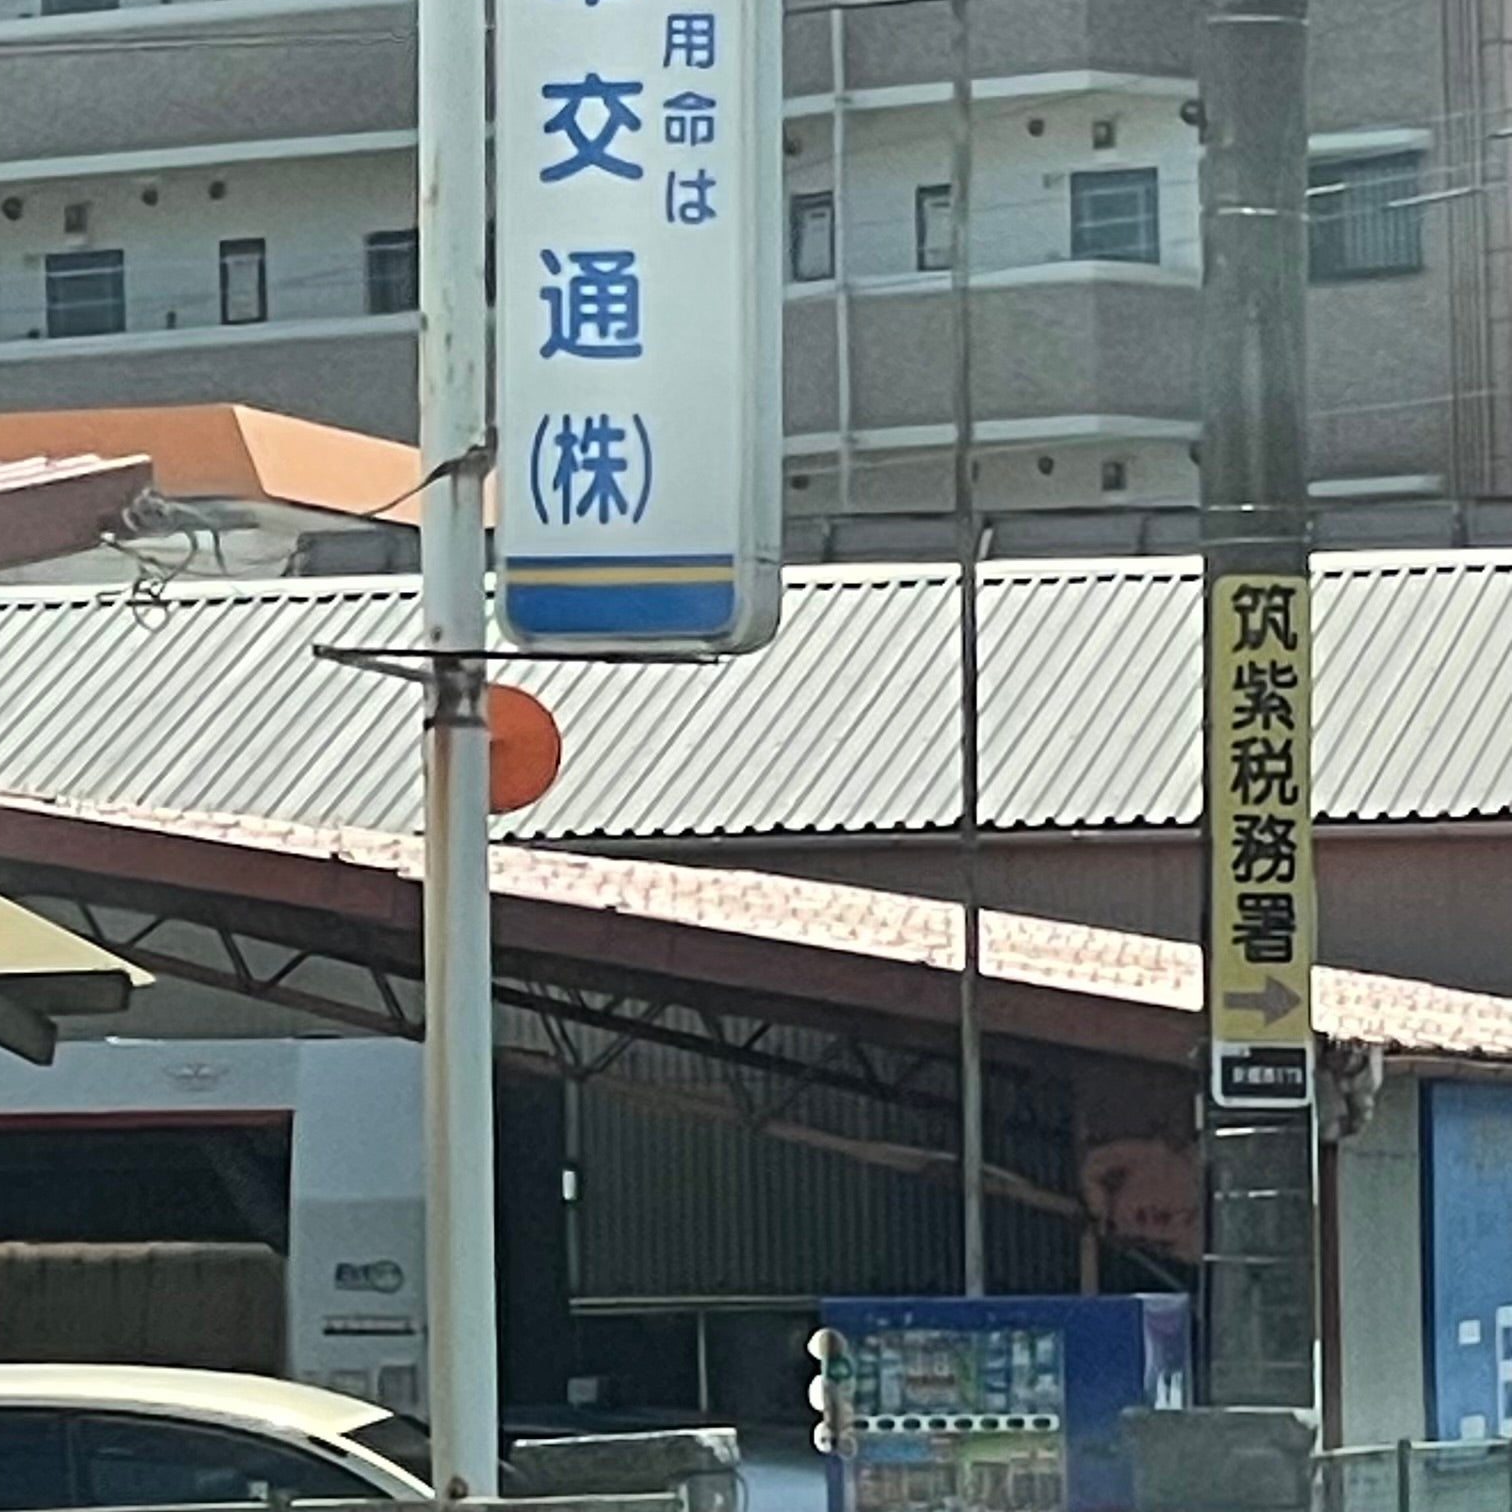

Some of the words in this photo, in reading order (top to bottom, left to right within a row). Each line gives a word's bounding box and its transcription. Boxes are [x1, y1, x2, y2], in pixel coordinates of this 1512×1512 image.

[1230, 583, 1299, 966] 筑紫税務署
